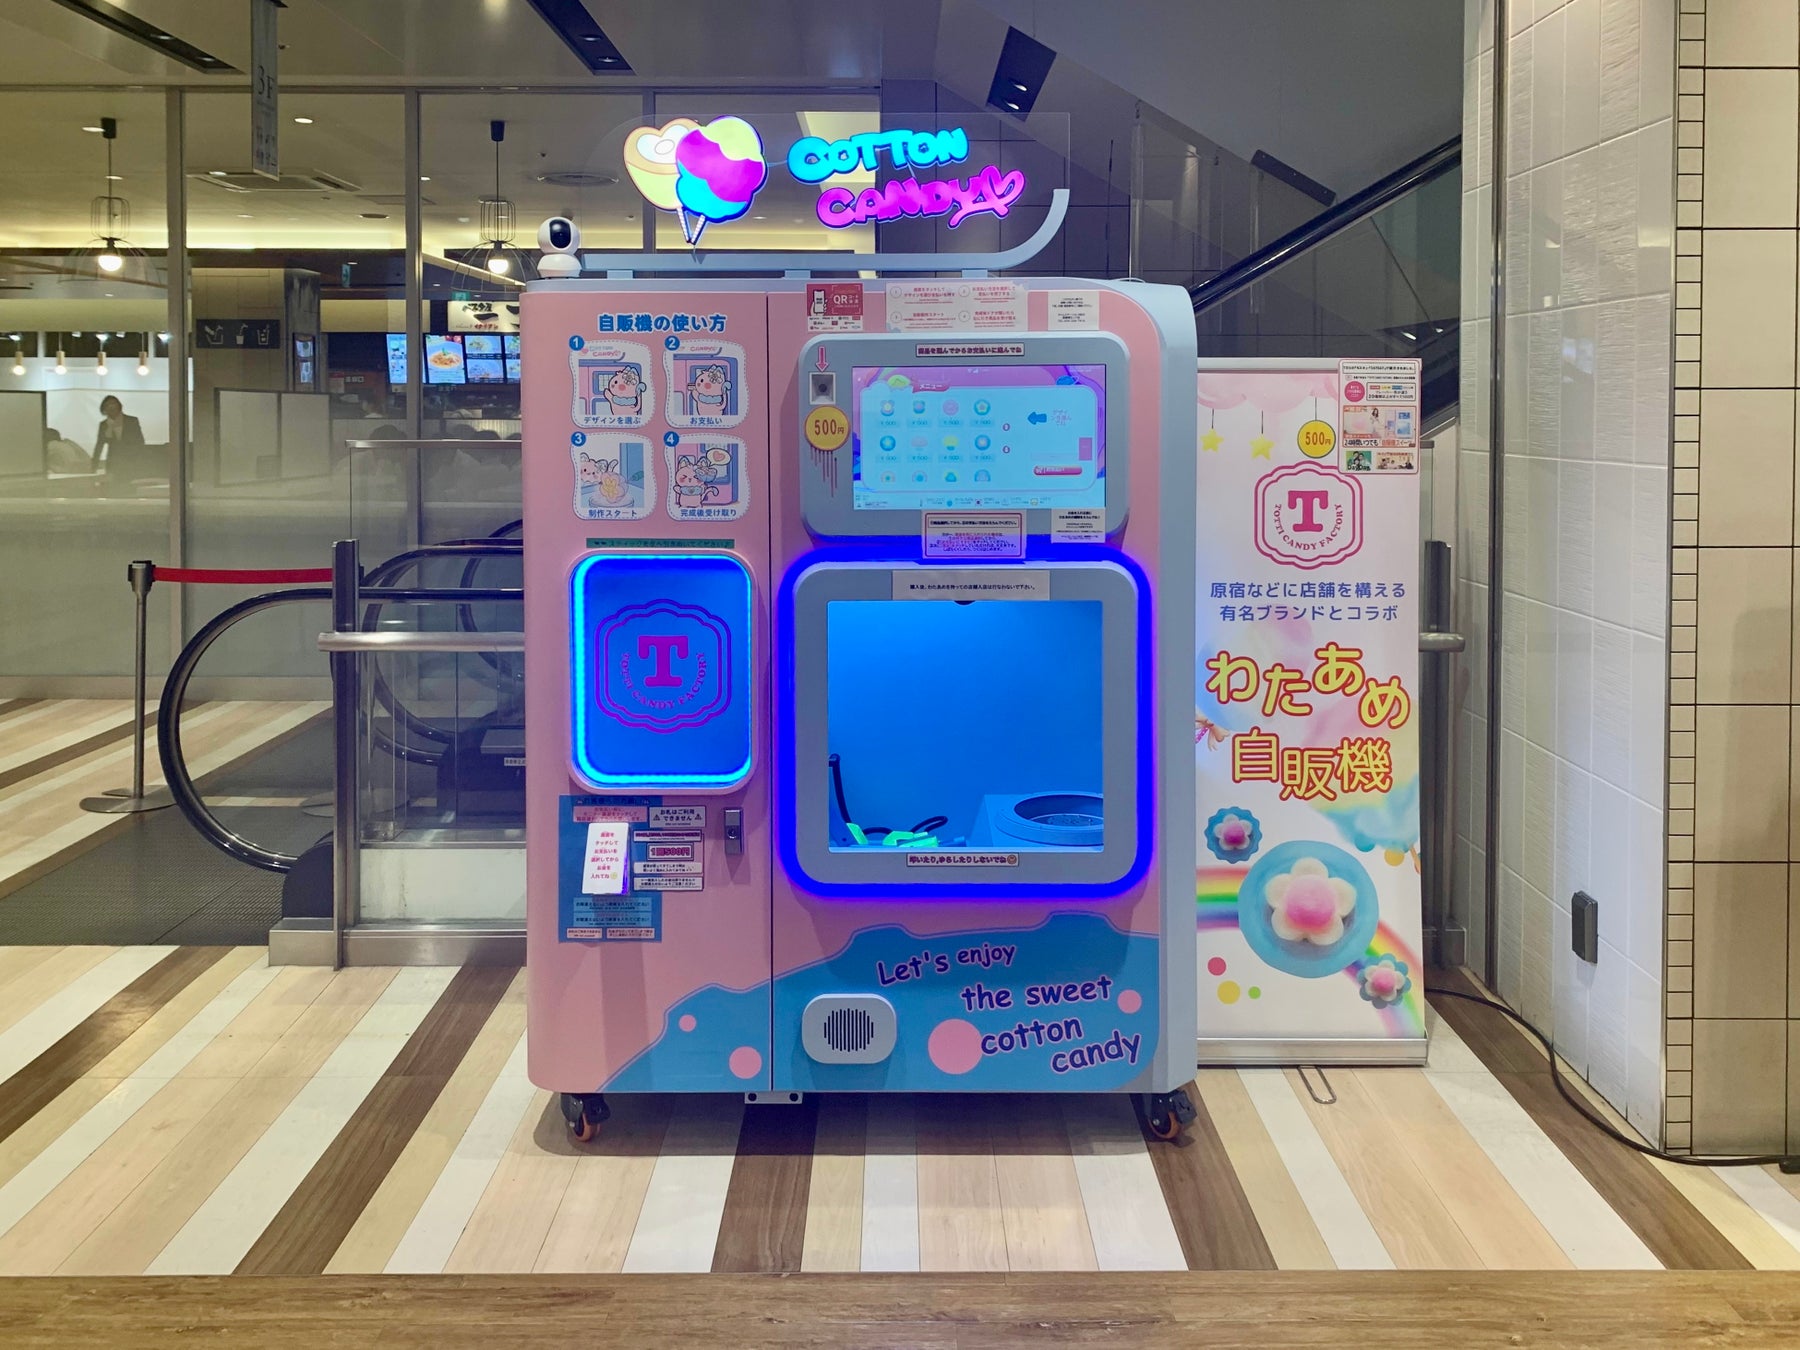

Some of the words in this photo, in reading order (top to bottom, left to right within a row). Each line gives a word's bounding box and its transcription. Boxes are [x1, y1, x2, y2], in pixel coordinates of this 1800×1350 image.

[257, 64, 276, 99] 3F
[787, 127, 969, 184] COTTON
[816, 165, 1025, 229] CANDY
[833, 294, 848, 304] QR
[598, 314, 727, 333] 自販機の使い方
[667, 337, 677, 349] 2
[583, 416, 642, 425] デザインを選ぶ
[689, 416, 724, 426] お支払い
[814, 419, 845, 436] 500円
[573, 433, 583, 445] 3
[666, 433, 676, 445] 4
[1305, 431, 1332, 446] 500円
[588, 508, 638, 518] 制作スタート
[680, 508, 737, 518] 完成後受け取り
[1287, 490, 1329, 533] T
[1273, 503, 1286, 535] TOTTI
[1282, 534, 1317, 551] CANDY
[1318, 503, 1344, 548] FACTORY
[1210, 582, 1406, 599] 原宿などに店舗を構える
[1219, 604, 1399, 622] 有名ブランドとコラボ
[638, 635, 689, 687] T
[631, 690, 675, 710] CANDY
[678, 652, 707, 705] FACTORY
[1206, 641, 1410, 729] わたあめ
[1231, 726, 1393, 801] 自販機
[876, 951, 949, 986] Let's
[956, 943, 1017, 969] enjoy
[961, 983, 1013, 1012] the
[1024, 975, 1113, 1007] sweet
[980, 1016, 1084, 1055] cotton
[1050, 1030, 1142, 1074] candy
